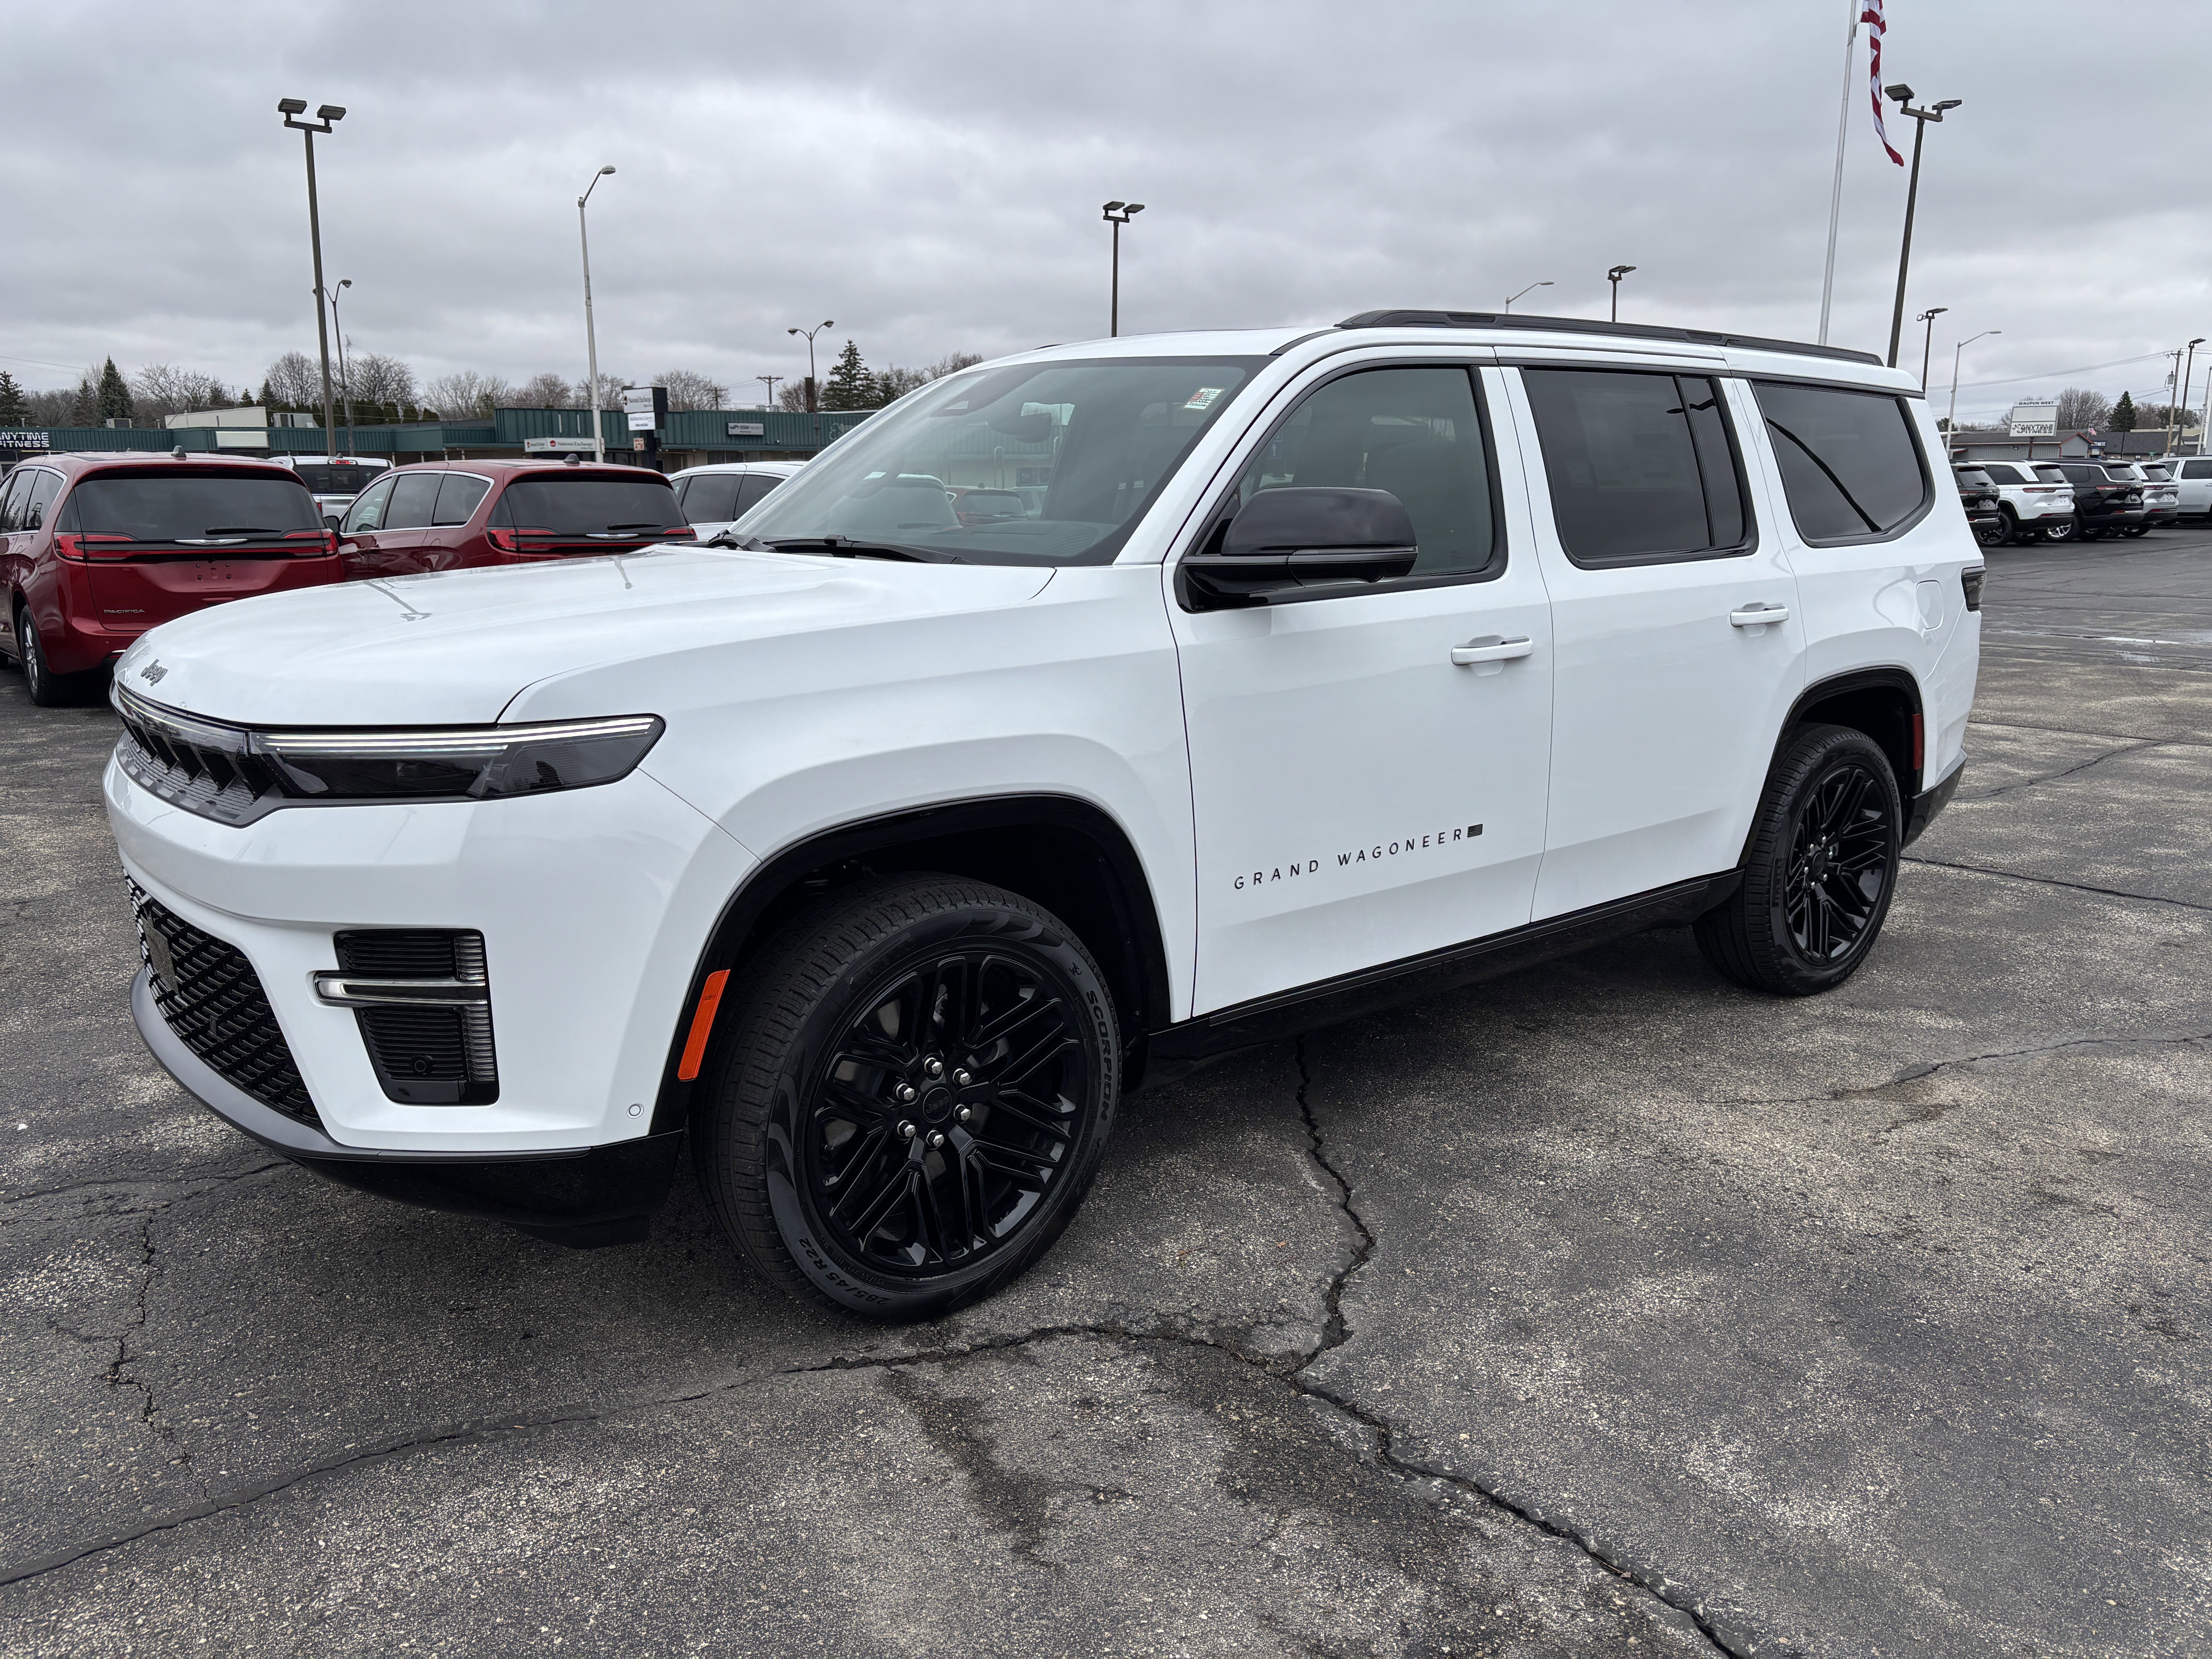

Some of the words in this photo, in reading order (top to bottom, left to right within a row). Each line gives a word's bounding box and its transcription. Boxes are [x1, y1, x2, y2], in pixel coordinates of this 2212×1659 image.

[141, 659, 168, 687] Jeep
[1234, 860, 1319, 890] GRAND
[1337, 828, 1462, 866] WAGONEER
[1085, 990, 1112, 1121] SCORPION
[926, 1096, 950, 1113] Jeep
[799, 1238, 828, 1270] R22
[825, 1272, 892, 1305] 285/45
